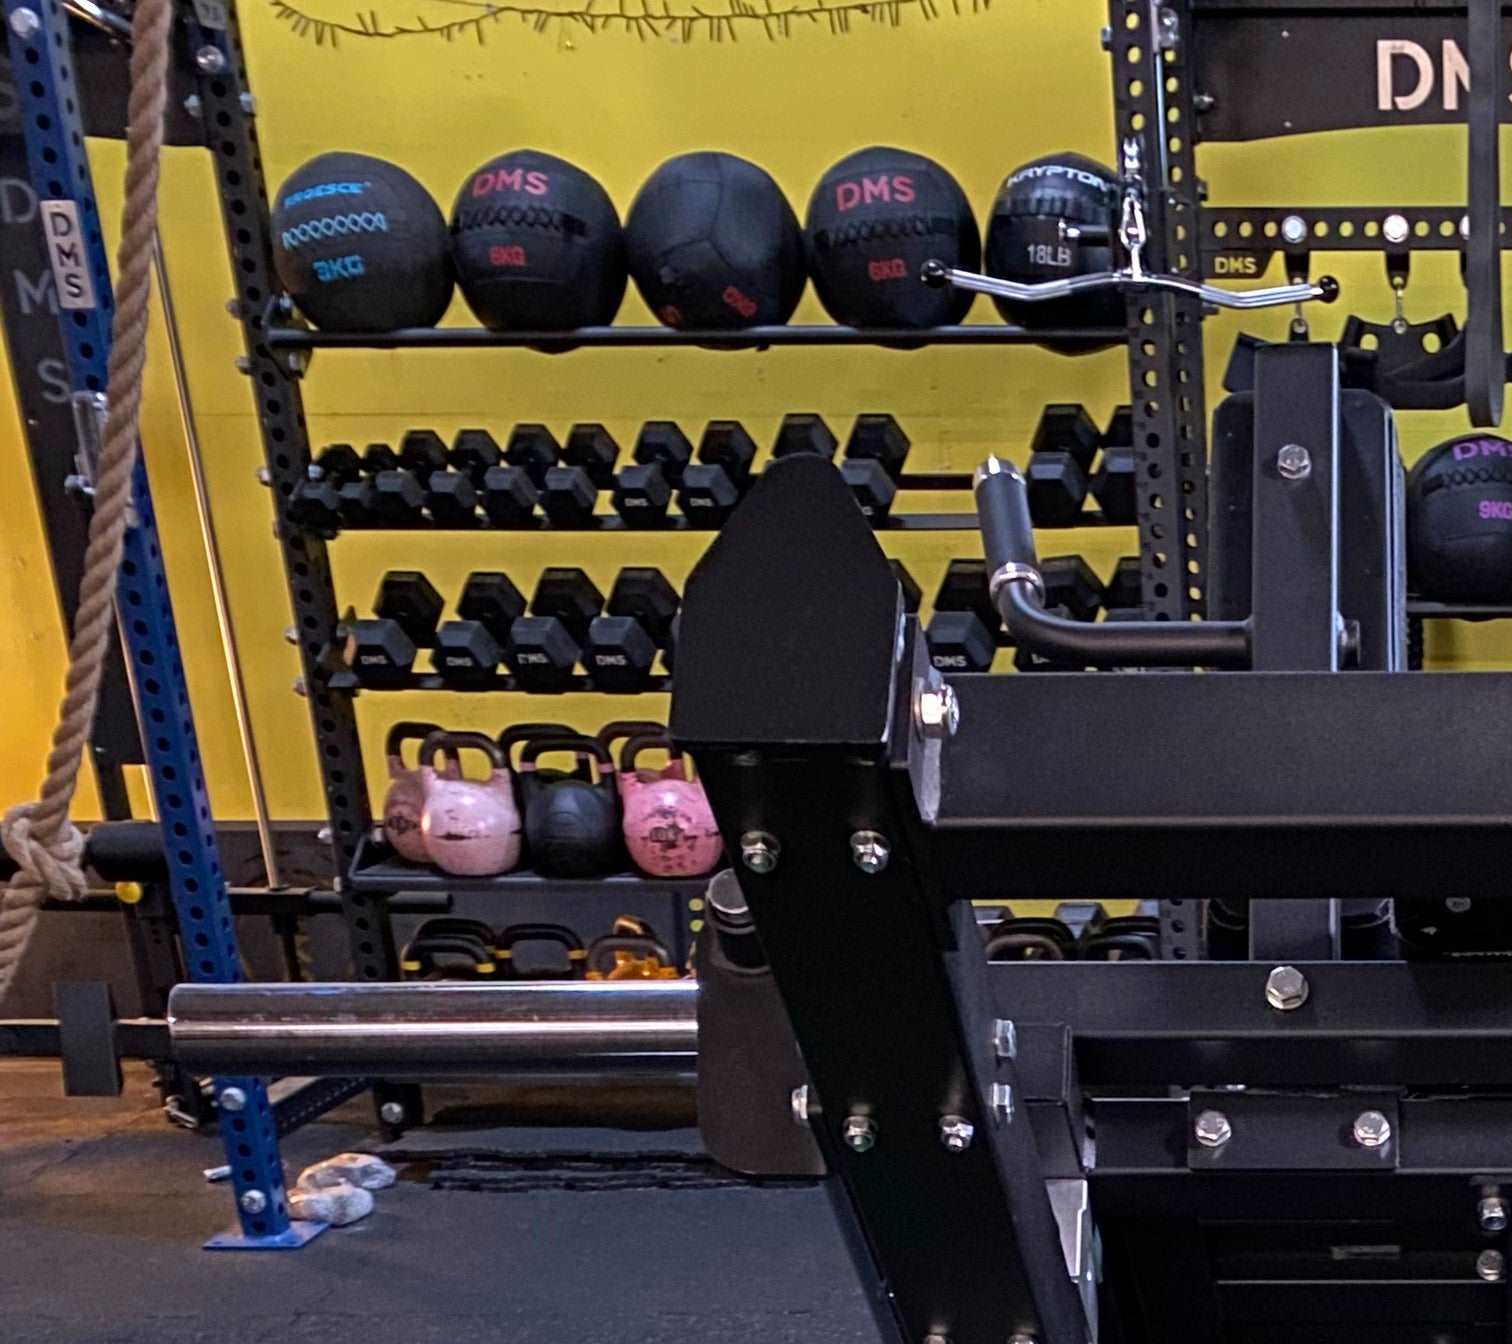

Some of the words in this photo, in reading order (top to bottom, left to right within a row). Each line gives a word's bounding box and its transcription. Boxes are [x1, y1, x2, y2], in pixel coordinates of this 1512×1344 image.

[472, 168, 549, 197] DMS
[836, 176, 916, 211] DMS
[50, 211, 83, 298] DMS
[1026, 244, 1073, 267] 18LB
[1214, 255, 1258, 275] DMS
[933, 655, 968, 667] DMS
